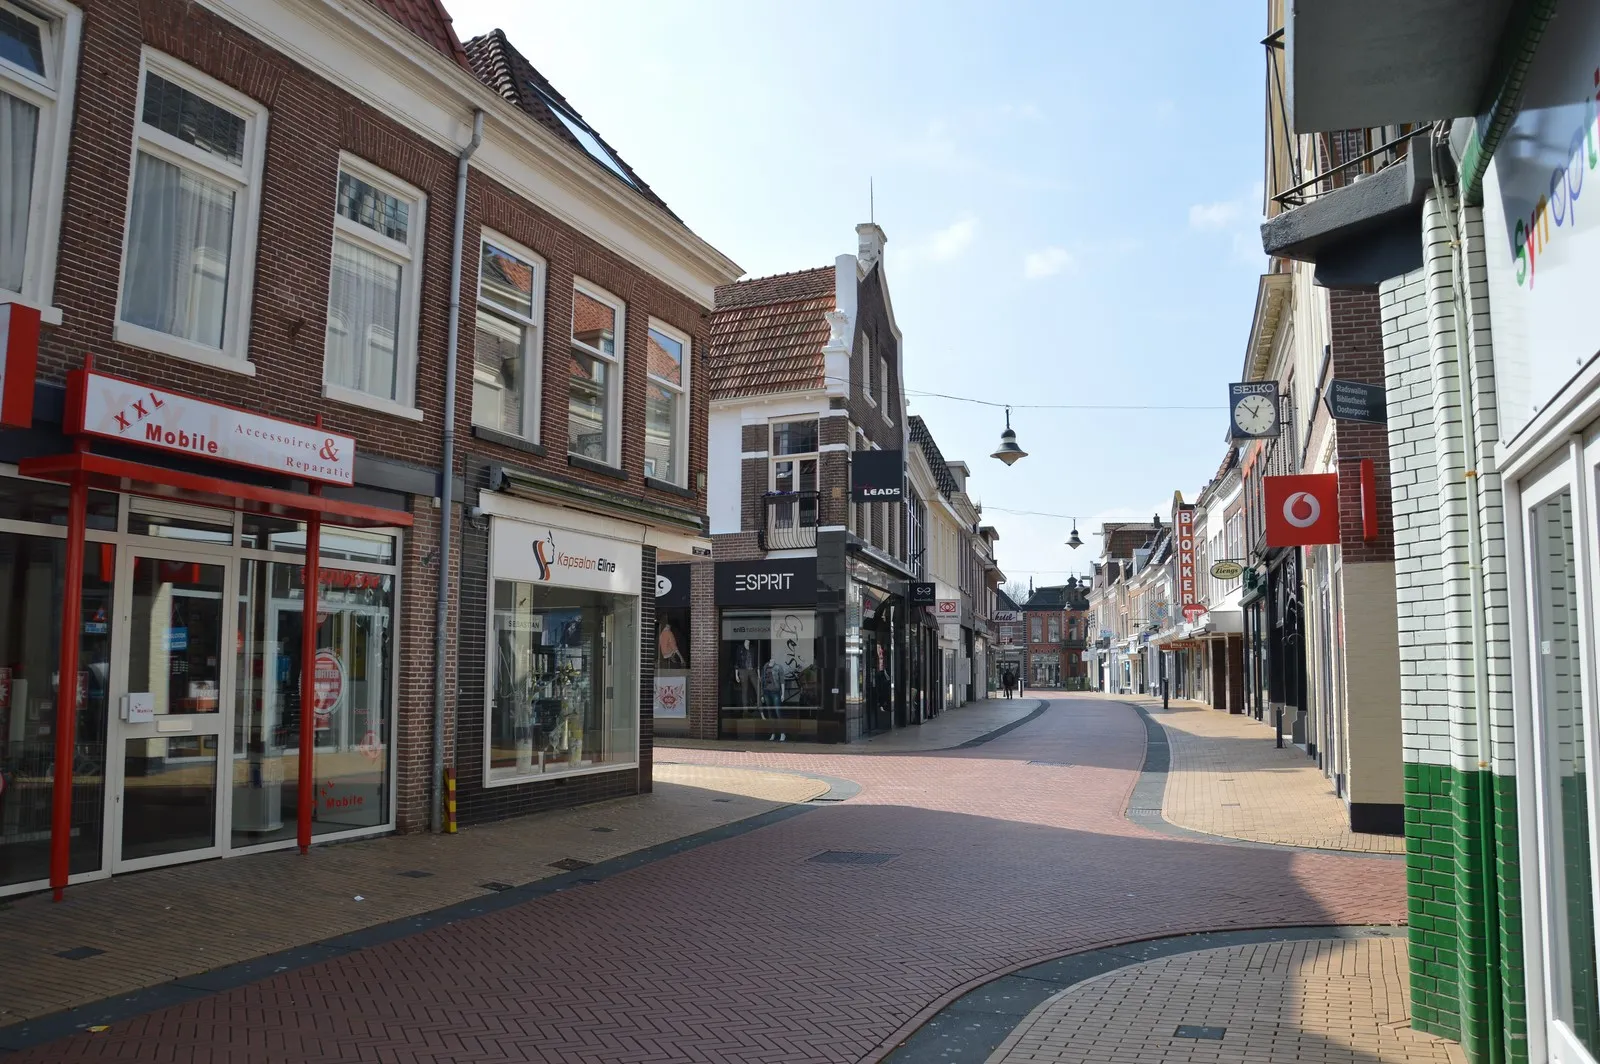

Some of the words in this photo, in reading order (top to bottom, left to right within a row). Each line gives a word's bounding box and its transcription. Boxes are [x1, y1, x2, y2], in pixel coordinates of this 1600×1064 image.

[1233, 383, 1274, 394] SEIKO
[1336, 384, 1367, 396] Stadswallen
[1336, 394, 1367, 405] Bibliotheek
[1336, 405, 1369, 416] Oosterpoort
[145, 422, 218, 453] Mobile
[234, 424, 317, 450] Accessoires
[319, 438, 339, 462] &
[286, 456, 350, 478] Reparatie
[863, 488, 901, 496] LEADS
[557, 552, 596, 569] Kapsalon
[597, 557, 616, 573] Elina
[1180, 512, 1194, 604] BLOKKER
[735, 573, 794, 591] ESPRIT
[326, 795, 363, 808] Mobile
